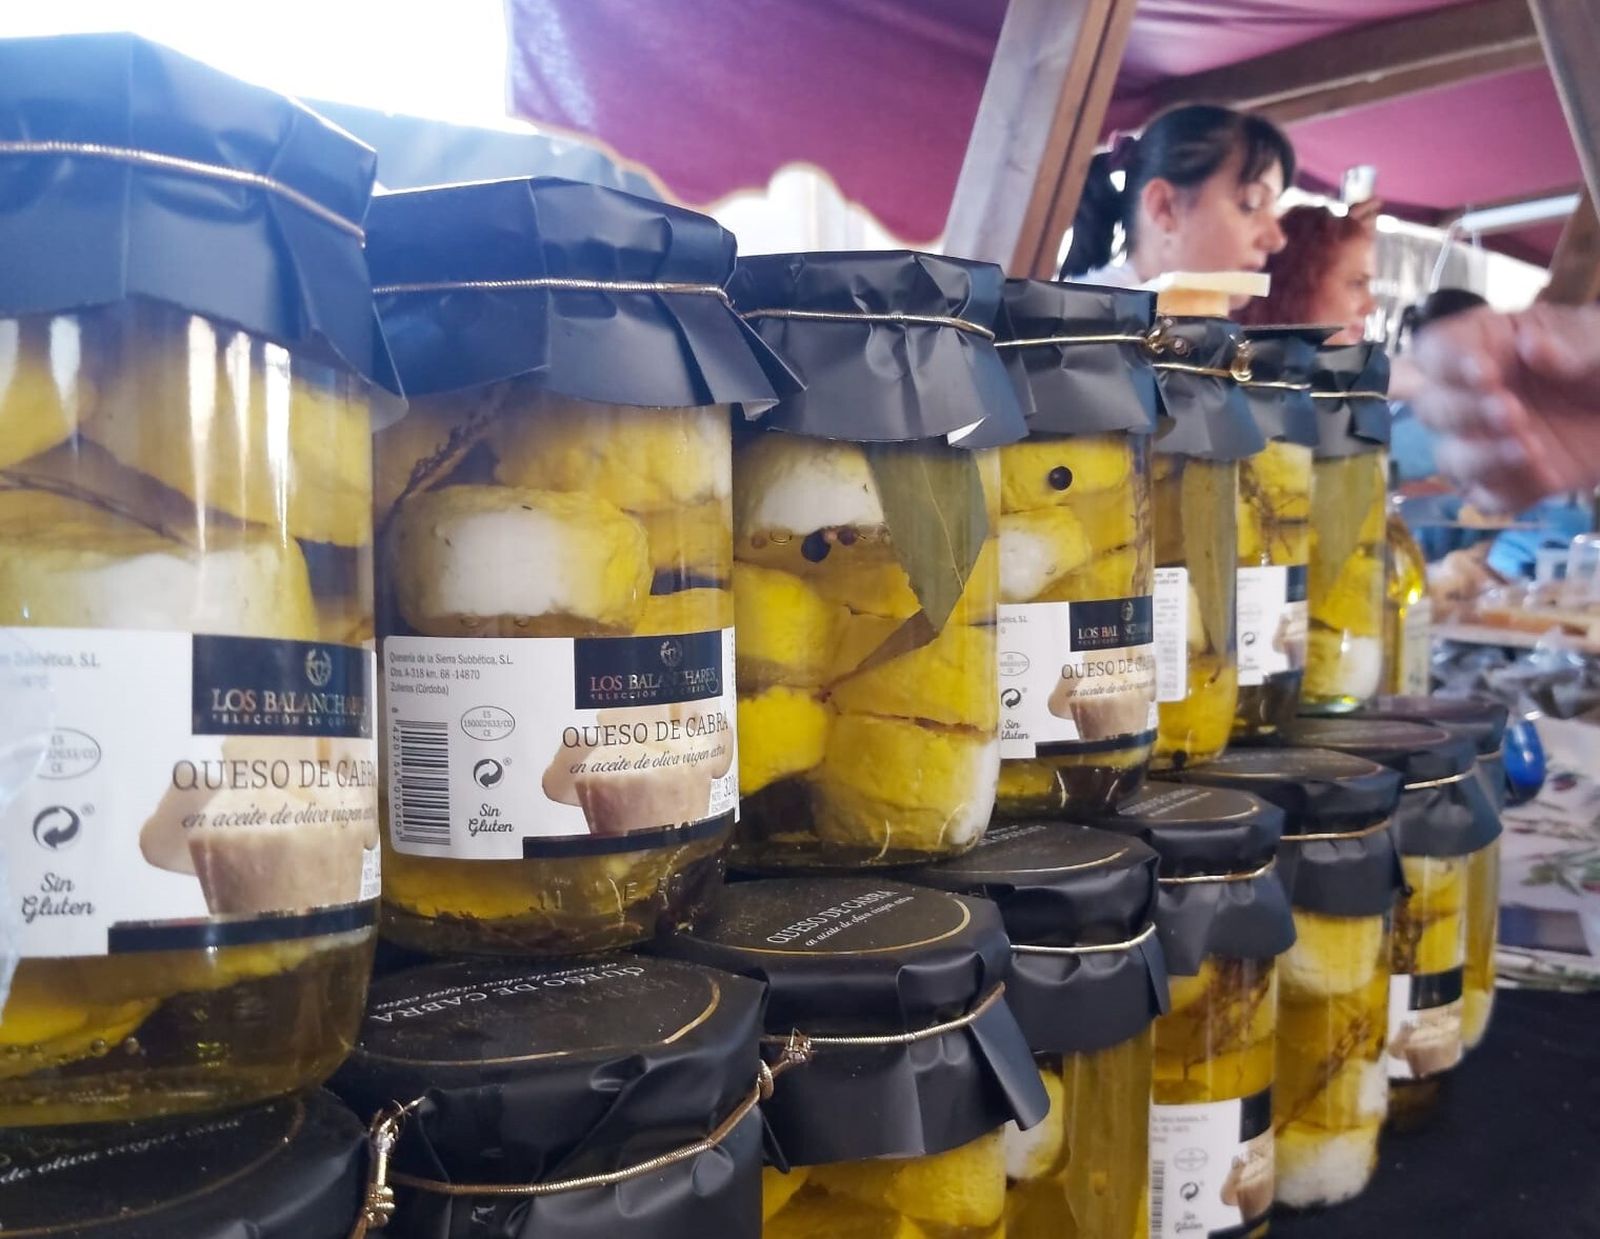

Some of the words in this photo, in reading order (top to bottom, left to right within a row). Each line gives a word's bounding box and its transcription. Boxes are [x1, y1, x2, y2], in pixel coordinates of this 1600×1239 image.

[1078, 627, 1099, 640] LOS
[435, 653, 457, 664] Sierra
[499, 654, 514, 665] S.L.
[1061, 660, 1115, 680] QUESO
[1118, 659, 1134, 675] DE
[440, 669, 450, 680] 68
[590, 675, 623, 692] LOS
[415, 683, 449, 696] (Córdoba)
[211, 688, 257, 713] LOS
[562, 722, 649, 749] QUESO
[655, 719, 682, 742] DE
[685, 710, 730, 740] CABRA
[1004, 719, 1020, 730] Sin
[569, 762, 587, 774] en
[590, 754, 630, 773] aceite
[633, 752, 651, 770] de
[652, 750, 681, 768] oliva
[682, 746, 710, 768] virgen
[171, 759, 290, 790] QUESO
[299, 760, 331, 789] DE
[181, 813, 204, 829] en
[212, 803, 264, 828] aceite
[270, 803, 290, 826] de
[294, 802, 328, 826] oliva
[478, 803, 502, 818] Sin
[468, 818, 515, 837] Gluten
[40, 873, 75, 894] Sin
[21, 896, 95, 924] Gluten
[766, 917, 828, 944] QUESO
[818, 906, 851, 918] DE
[840, 890, 900, 909] CABRA
[805, 939, 818, 947] en
[840, 920, 854, 929] de
[542, 966, 646, 988] QUESO
[491, 983, 539, 997] DE
[368, 992, 489, 1024] CABRA
